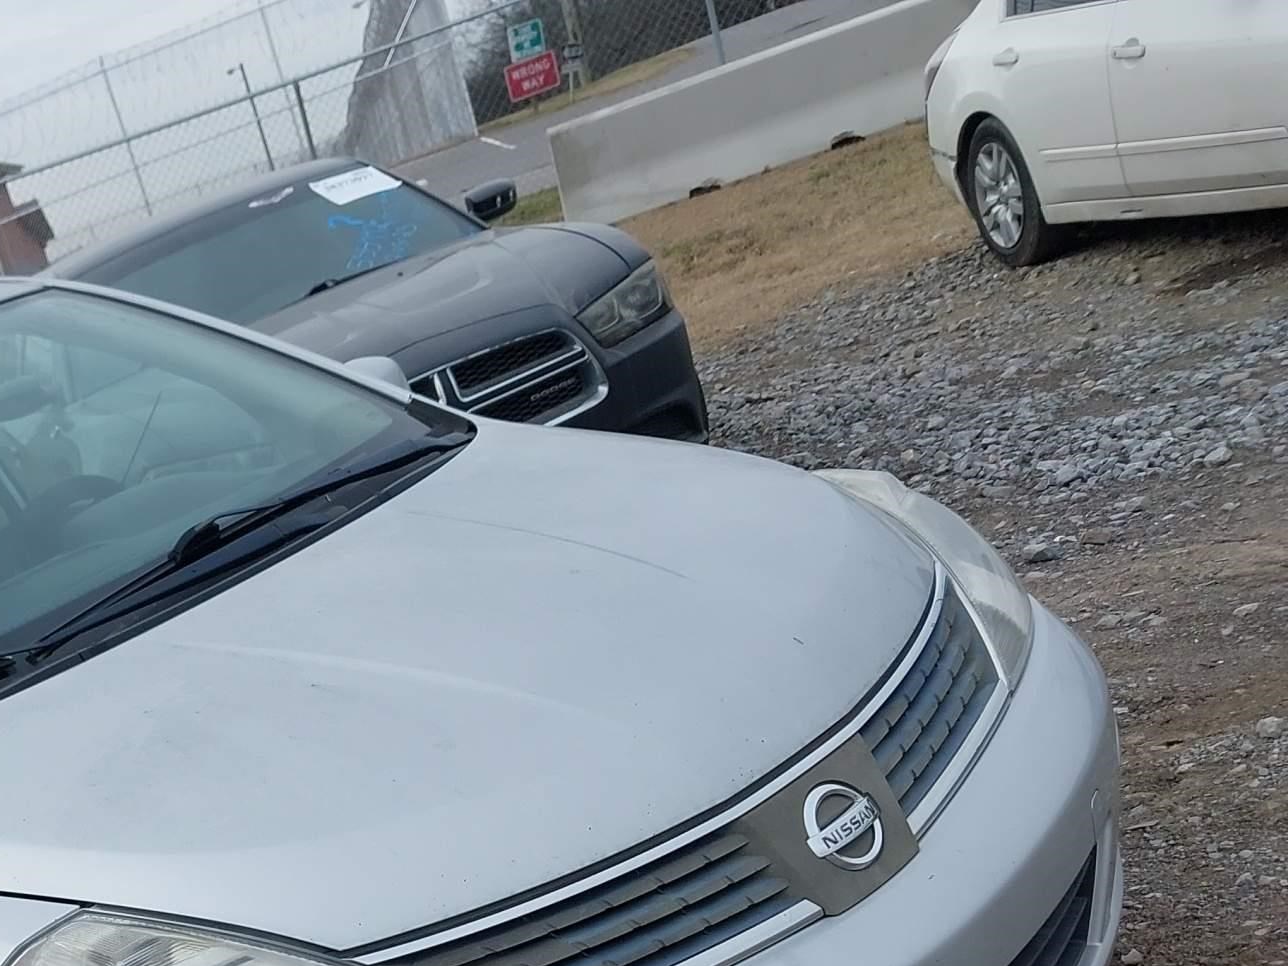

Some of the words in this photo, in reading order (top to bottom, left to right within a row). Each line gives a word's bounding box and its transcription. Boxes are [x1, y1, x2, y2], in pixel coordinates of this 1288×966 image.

[511, 58, 550, 80] WRONG
[521, 73, 544, 91] WAY
[821, 804, 876, 849] NISSAN
